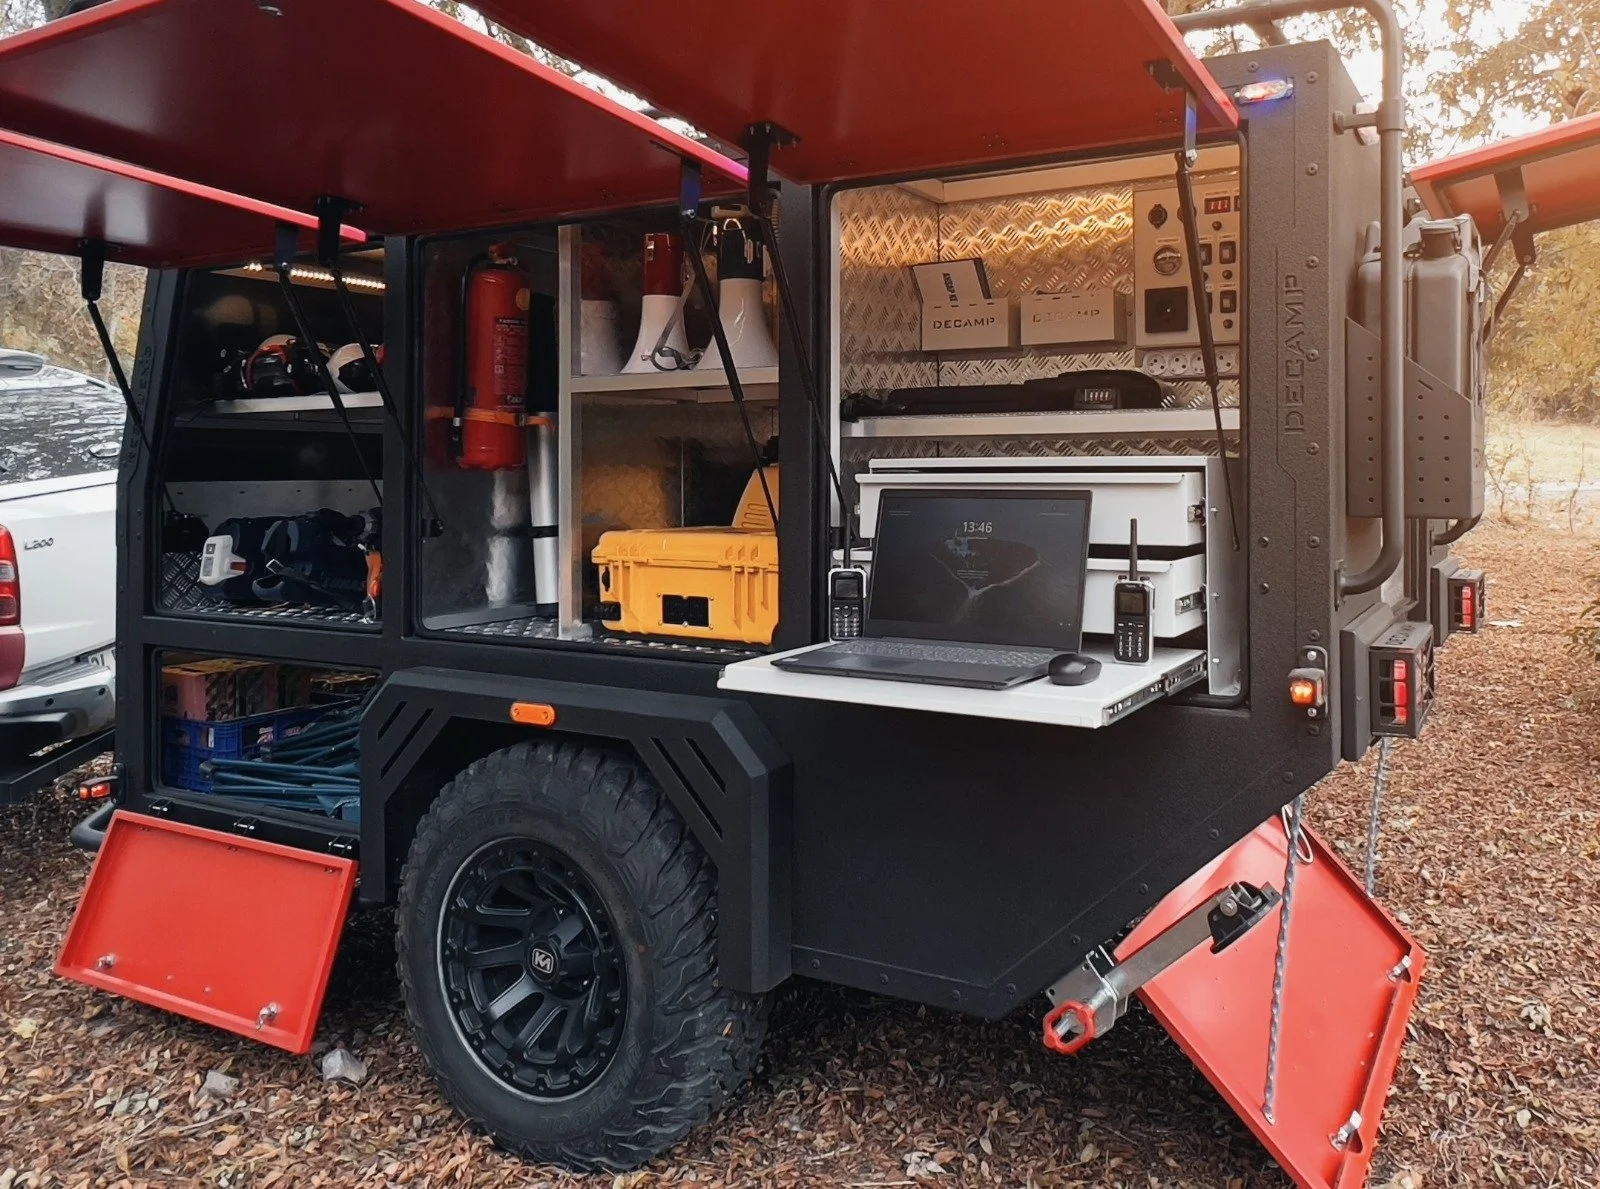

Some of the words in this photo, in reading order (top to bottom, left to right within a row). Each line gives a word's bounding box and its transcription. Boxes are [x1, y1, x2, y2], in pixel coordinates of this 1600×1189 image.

[933, 317, 995, 330] DECAMP
[1284, 274, 1305, 434] DECAMP
[962, 521, 993, 534] 13:46
